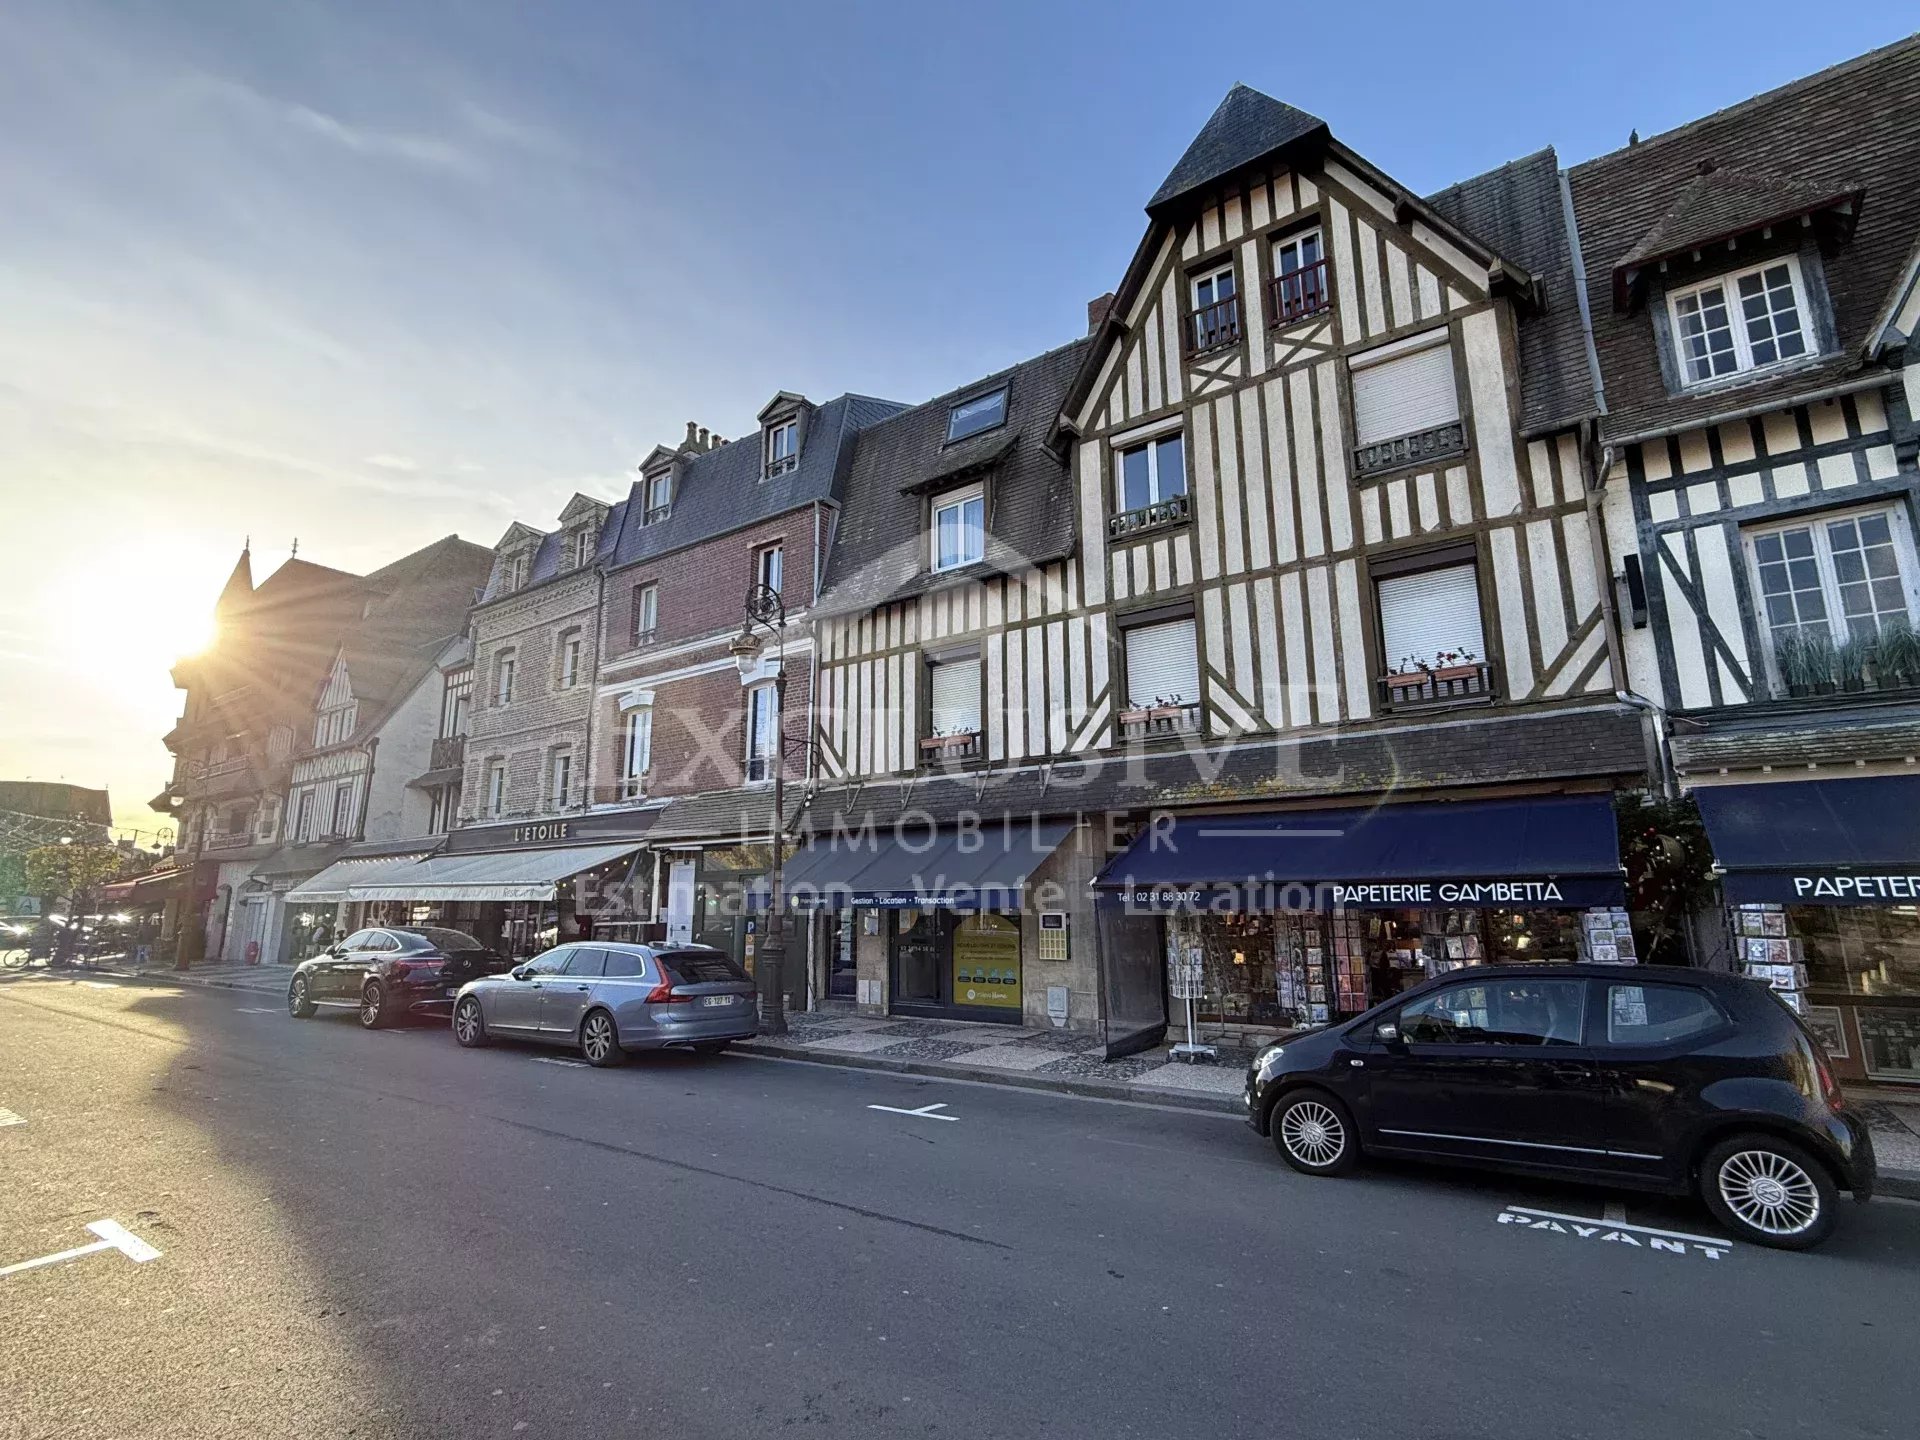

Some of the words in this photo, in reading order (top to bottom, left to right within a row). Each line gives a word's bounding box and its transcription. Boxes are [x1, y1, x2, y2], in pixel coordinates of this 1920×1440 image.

[514, 823, 568, 842] L'ETOILE
[851, 897, 873, 905] Gestion
[879, 897, 906, 905] Location
[914, 896, 955, 905] Transaction
[1136, 892, 1148, 902] 02
[1149, 892, 1159, 902] 31
[1162, 892, 1174, 902] 88
[1175, 891, 1187, 902] 30
[1188, 891, 1201, 901] 72
[1333, 884, 1431, 903] PAPETERIE
[1438, 882, 1564, 902] GAMBETTA
[1497, 1212, 1729, 1260] PAYANT
